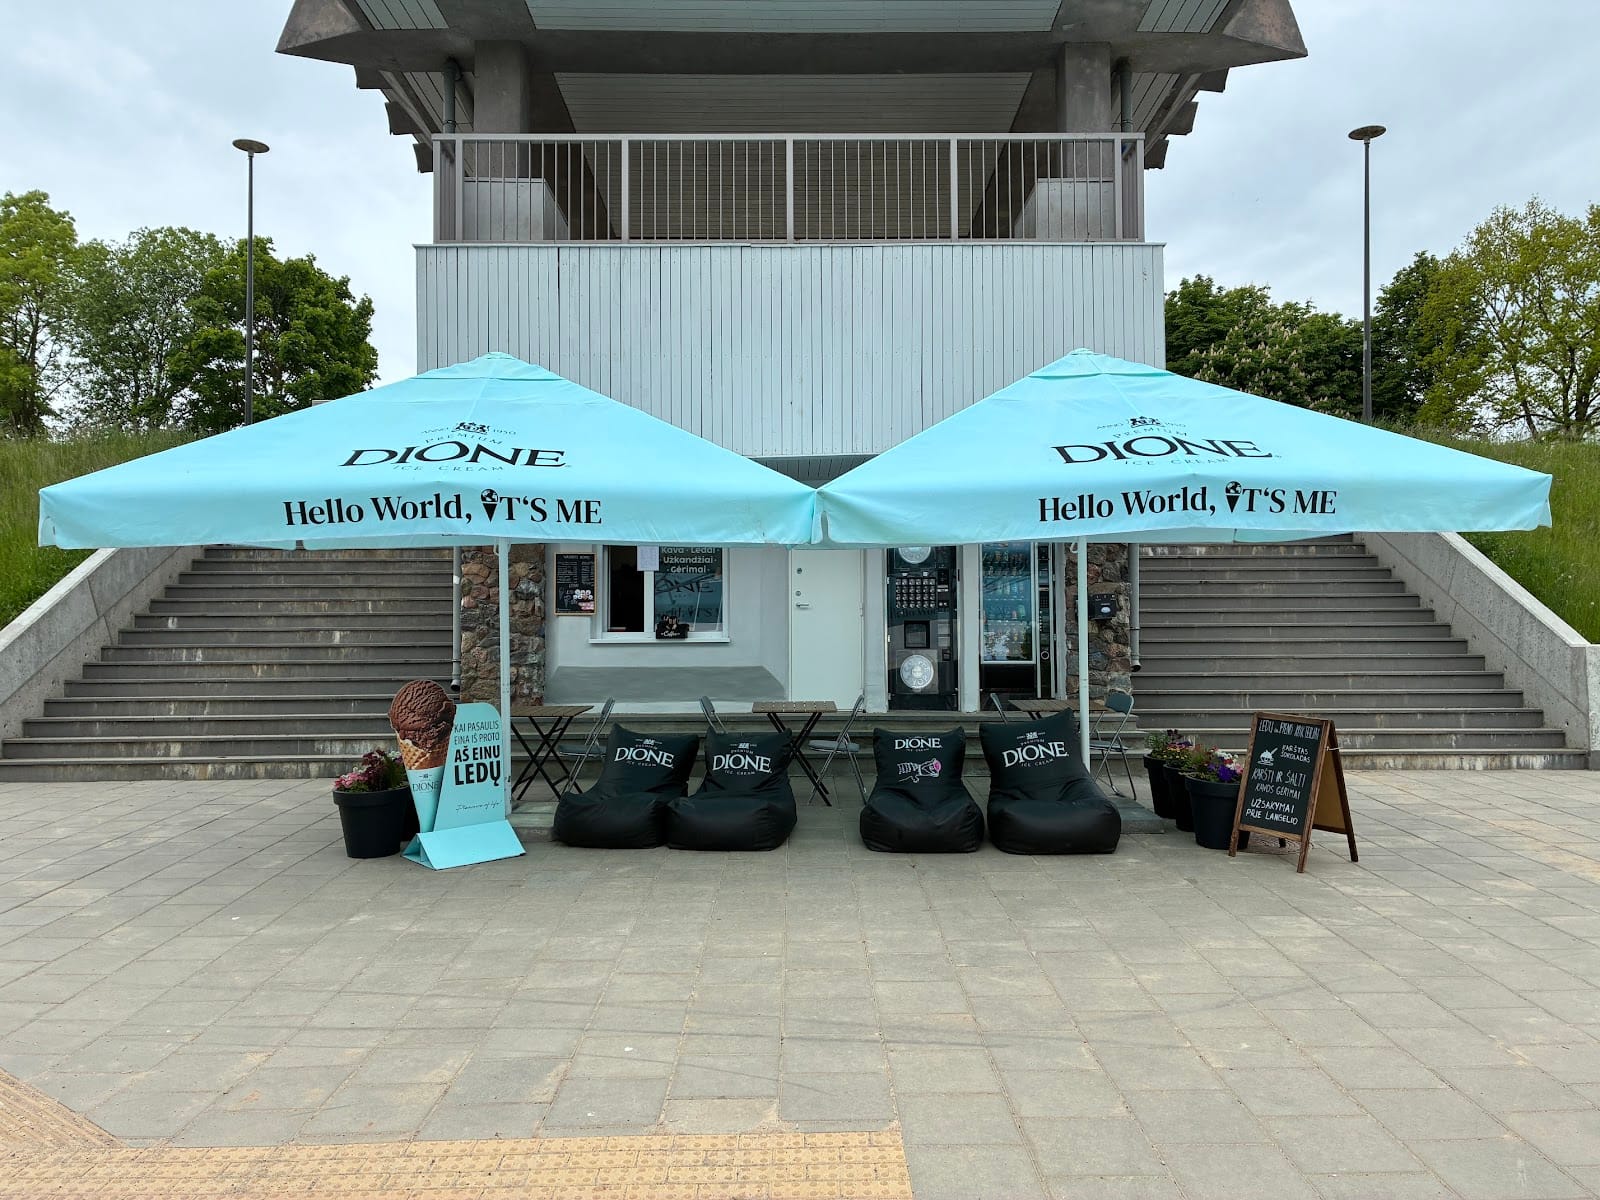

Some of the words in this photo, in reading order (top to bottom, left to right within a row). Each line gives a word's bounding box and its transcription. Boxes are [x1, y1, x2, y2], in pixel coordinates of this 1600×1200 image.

[424, 432, 503, 445] PREMIUM
[339, 440, 567, 467] DIONE
[1050, 436, 1273, 464] DIONE
[283, 498, 365, 525] Hello
[370, 492, 473, 524] World,
[556, 498, 602, 524] ME
[1038, 493, 1113, 522] Hello
[1121, 486, 1216, 517] World,
[1293, 490, 1338, 515] ME
[663, 555, 713, 564] Užkandžiai
[670, 565, 706, 573] Gėrimai
[454, 723, 466, 733] KAI
[467, 720, 500, 732] PASAULIS
[454, 735, 470, 745] EINA
[471, 733, 478, 744] IŠ
[479, 732, 500, 743] PROTO
[895, 738, 942, 750] DIONE
[454, 745, 470, 763] AŠ
[472, 745, 500, 761] EINU
[614, 747, 674, 768] DIONE
[1002, 741, 1067, 768] DIONE
[1281, 744, 1309, 755] KARŠTAS
[712, 753, 771, 773] DIONE
[454, 760, 501, 786] LEDŲ
[1285, 769, 1306, 788] ŠALTI
[412, 780, 440, 792] DIONE
[1250, 797, 1295, 814] UŽSAKYMAI
[1245, 808, 1262, 819] PRIE
[1265, 812, 1299, 825] LANGELIO
